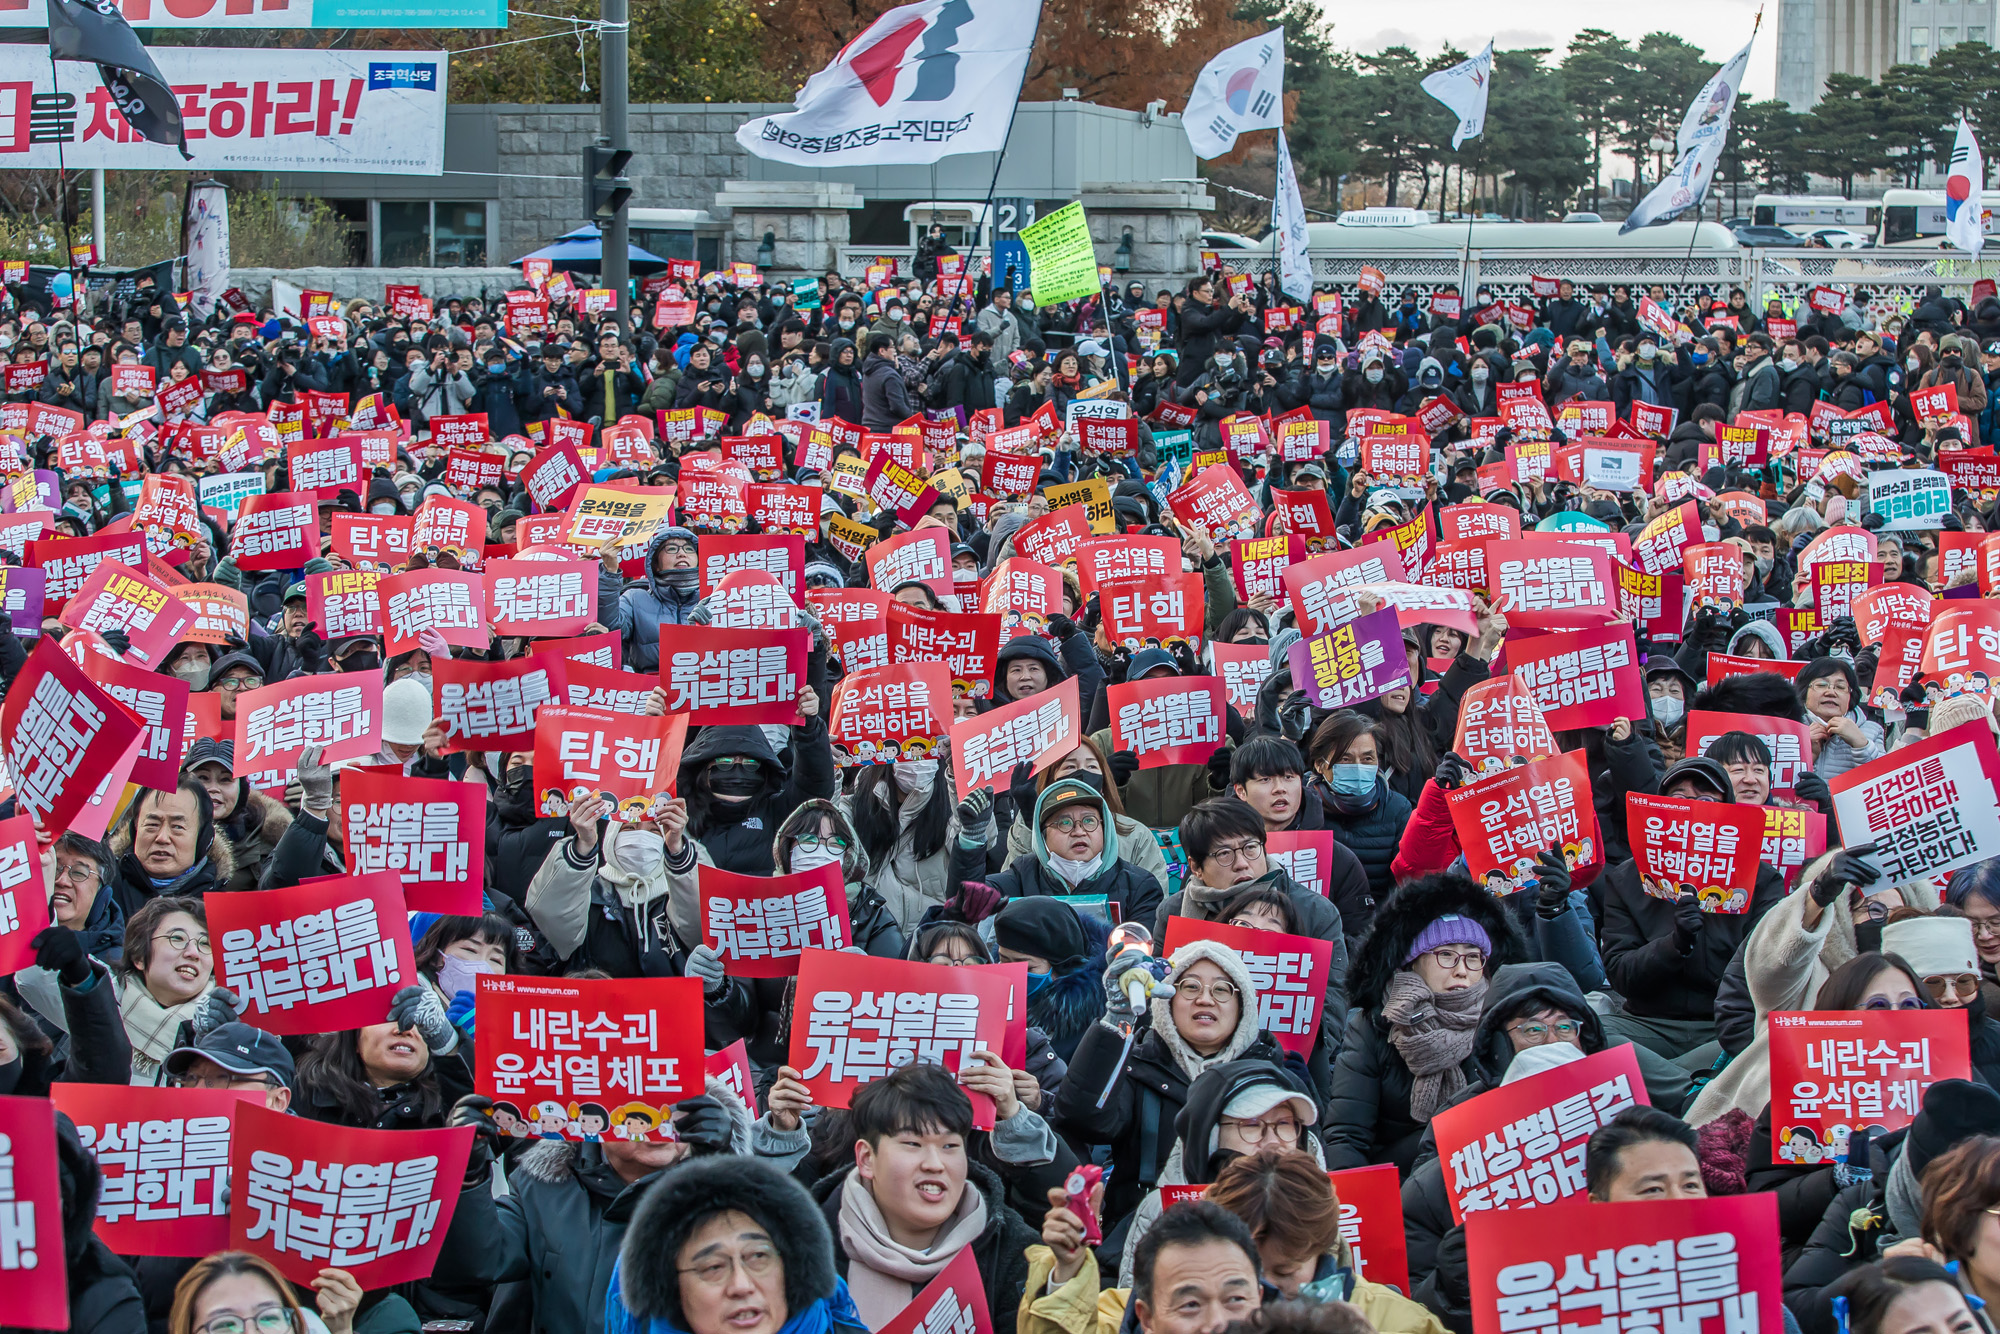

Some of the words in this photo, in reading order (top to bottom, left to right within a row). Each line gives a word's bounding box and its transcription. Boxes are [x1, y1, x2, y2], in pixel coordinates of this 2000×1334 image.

[374, 68, 431, 83] 조국혁신당
[998, 205, 1017, 233] 2
[673, 265, 695, 279] 탄핵
[1917, 391, 1948, 412] 탄핵
[37, 411, 76, 428] 윤석열을
[440, 422, 478, 432] 내란수괴
[1086, 425, 1127, 438] 윤석열을
[1160, 408, 1191, 426] 탄핵
[1285, 421, 1319, 436] 내란죄
[436, 433, 467, 445] 윤석열
[468, 432, 485, 443] 체포
[613, 436, 651, 459] 탄핵
[833, 426, 858, 448] 탄핵
[1087, 436, 1127, 449] 탄핵하라
[1284, 433, 1319, 449] 윤석열
[1722, 426, 1758, 441] 내란죄
[1722, 440, 1757, 455] 윤석열
[61, 437, 105, 465] 탄핵
[731, 444, 770, 456] 내란수괴
[870, 442, 912, 457] 윤석열을
[1285, 446, 1312, 461] 탄핵!
[1371, 443, 1421, 459] 윤석열을
[1515, 442, 1549, 458] 내란죄
[1517, 455, 1551, 470] 윤석열
[882, 458, 929, 495] 내란죄
[994, 461, 1035, 478] 윤석열을
[1372, 458, 1421, 474] 탄핵하라
[1952, 462, 1997, 475] 내란수괴
[692, 484, 739, 500] 내란수괴
[992, 474, 1032, 493] 탄핵하라
[1191, 478, 1238, 514] 내란수괴
[1872, 480, 1910, 500] 내란수괴
[1912, 476, 1947, 491] 윤석열을
[139, 504, 178, 525] 윤석열
[416, 506, 470, 523] 윤석열을
[580, 498, 647, 517] 윤석열을
[685, 496, 722, 513] 윤석열
[724, 498, 746, 513] 체포
[754, 509, 790, 525] 윤석열
[791, 511, 814, 525] 체포
[762, 494, 809, 510] 내란수괴
[1228, 497, 1250, 515] 체포
[1873, 489, 1950, 524] 탄핵하라
[233, 504, 313, 533] 김건희특검
[1278, 504, 1319, 533] 탄핵
[1456, 514, 1510, 532] 윤석열을
[232, 529, 303, 557] 수용하라!
[1023, 519, 1072, 554] 내란수괴
[1241, 539, 1289, 562] 내란죄
[706, 547, 790, 581] 윤석열을
[873, 537, 938, 580] 윤석열을
[1093, 547, 1165, 569] 윤석열을
[1242, 556, 1290, 580] 윤석열
[1499, 556, 1596, 589] 윤석열을
[323, 574, 381, 596] 내란죄
[493, 572, 583, 603] 윤석열을
[988, 568, 1047, 599] 윤석열을
[1618, 565, 1662, 597] 내란죄
[1819, 563, 1869, 585] 내란죄
[102, 573, 169, 614] 내란죄
[323, 592, 380, 616] 윤석열
[388, 582, 470, 617] 윤석열을
[493, 593, 588, 623] 거부한다!
[1501, 580, 1606, 612] 거부한다!
[1819, 582, 1869, 604] 윤석열
[93, 593, 156, 633] 윤석열
[324, 612, 373, 635] 탄핵!
[1112, 589, 1185, 633] 탄핵
[902, 623, 975, 653] 내란수괴
[1309, 623, 1356, 665] 퇴진
[670, 645, 788, 682] 윤석열을
[949, 652, 984, 675] 체포
[1314, 639, 1385, 688] 광장을
[1515, 638, 1631, 689] 채상병특검
[671, 673, 796, 711] 거부한다!
[842, 681, 930, 713] 윤석열을
[1318, 674, 1376, 709] 열자!
[245, 686, 362, 734] 윤석열을
[840, 708, 933, 741] 탄핵하라
[1118, 689, 1212, 730] 윤석열을
[1464, 694, 1548, 726] 윤석열을
[245, 709, 371, 761] 거부한다!
[963, 696, 1062, 763] 윤석열을
[1119, 713, 1218, 755] 거부한다!
[1464, 725, 1553, 756] 탄핵하라
[559, 730, 661, 789] 탄핵
[1451, 789, 1475, 803] 나눔문화
[1476, 774, 1520, 794] www.nanum.com
[1863, 756, 1946, 813] 김건희를
[1480, 777, 1575, 833] 윤석열을
[1629, 795, 1648, 805] 나눔문화
[1649, 801, 1691, 811] www.nanum.com
[1868, 781, 1960, 833] 특검하라!
[347, 800, 460, 845] 윤석열을
[1487, 809, 1579, 864] 탄핵하라
[1644, 816, 1740, 847] 윤석열을
[1874, 807, 1962, 857] 국정농단
[1646, 847, 1736, 885] 탄핵하라
[1883, 829, 1979, 883] 규탄한다!
[708, 885, 829, 930] 윤석열을
[222, 898, 381, 976] 윤석열을
[708, 913, 843, 961] 거부한다!
[226, 938, 401, 1015] 거부한다!
[482, 979, 516, 992] 나눔문화
[516, 985, 580, 996] www.nanum.com
[808, 990, 980, 1039] 윤석열을
[1775, 1016, 1807, 1027] 나눔문화
[1808, 1019, 1863, 1027] www.nanum.com
[512, 1008, 658, 1053] 내란수괴
[237, 1045, 249, 1054] K2
[1806, 1038, 1931, 1077] 내란수괴
[492, 1053, 602, 1096] 윤석열
[606, 1054, 683, 1096] 체포
[1790, 1079, 1884, 1119] 윤석열
[1449, 1073, 1635, 1195] 채상병특검
[247, 1149, 439, 1217] 윤석열을
[246, 1195, 442, 1268] 거부한다!
[1496, 1231, 1740, 1334] 윤석열을
